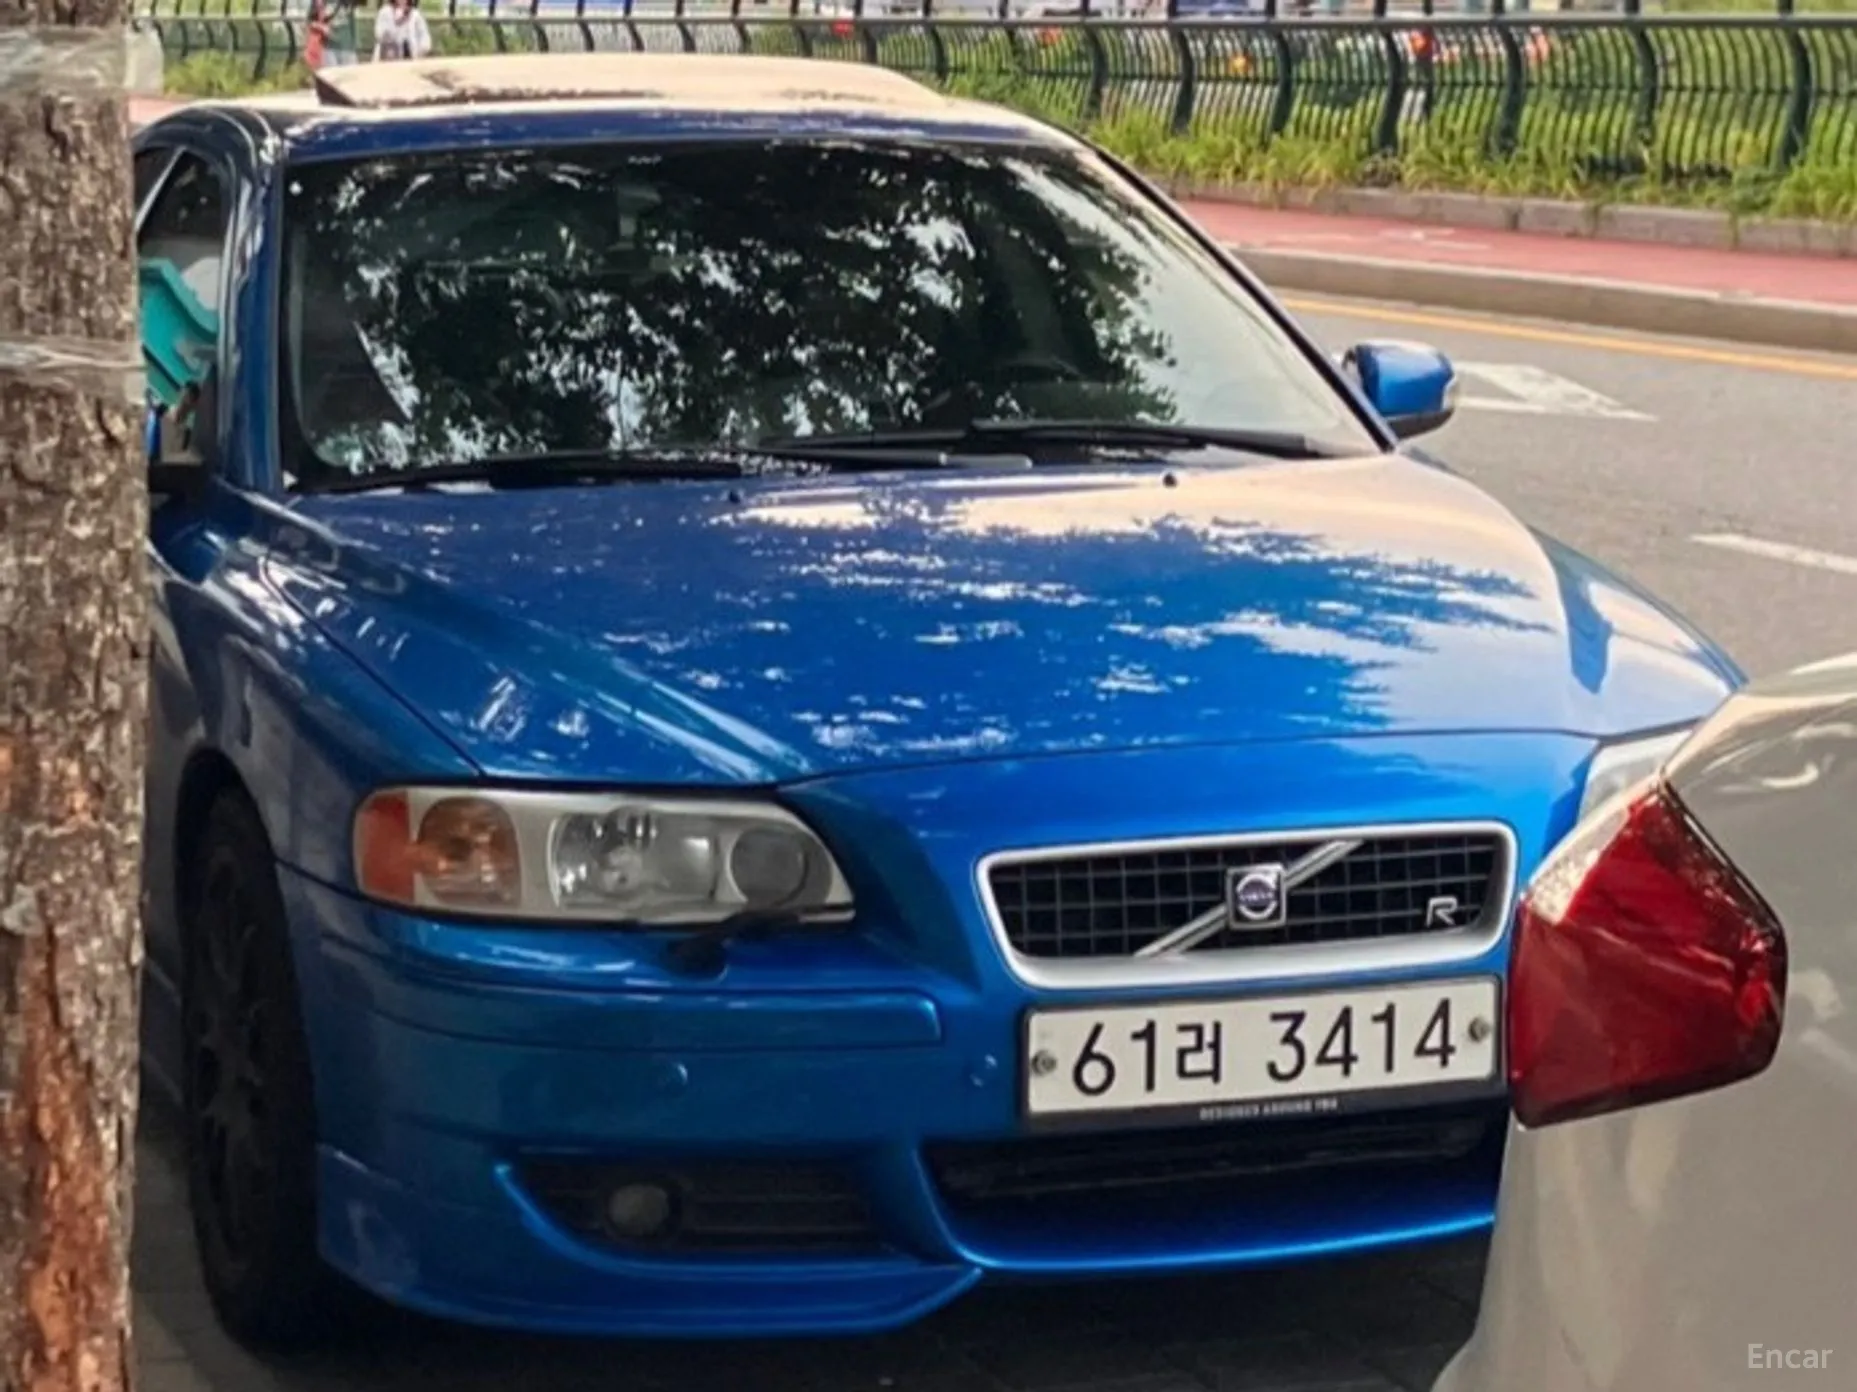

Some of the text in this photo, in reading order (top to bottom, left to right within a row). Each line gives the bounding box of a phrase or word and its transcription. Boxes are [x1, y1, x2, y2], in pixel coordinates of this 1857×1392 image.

[1425, 896, 1458, 928] R
[1072, 998, 1457, 1097] 61러 3414
